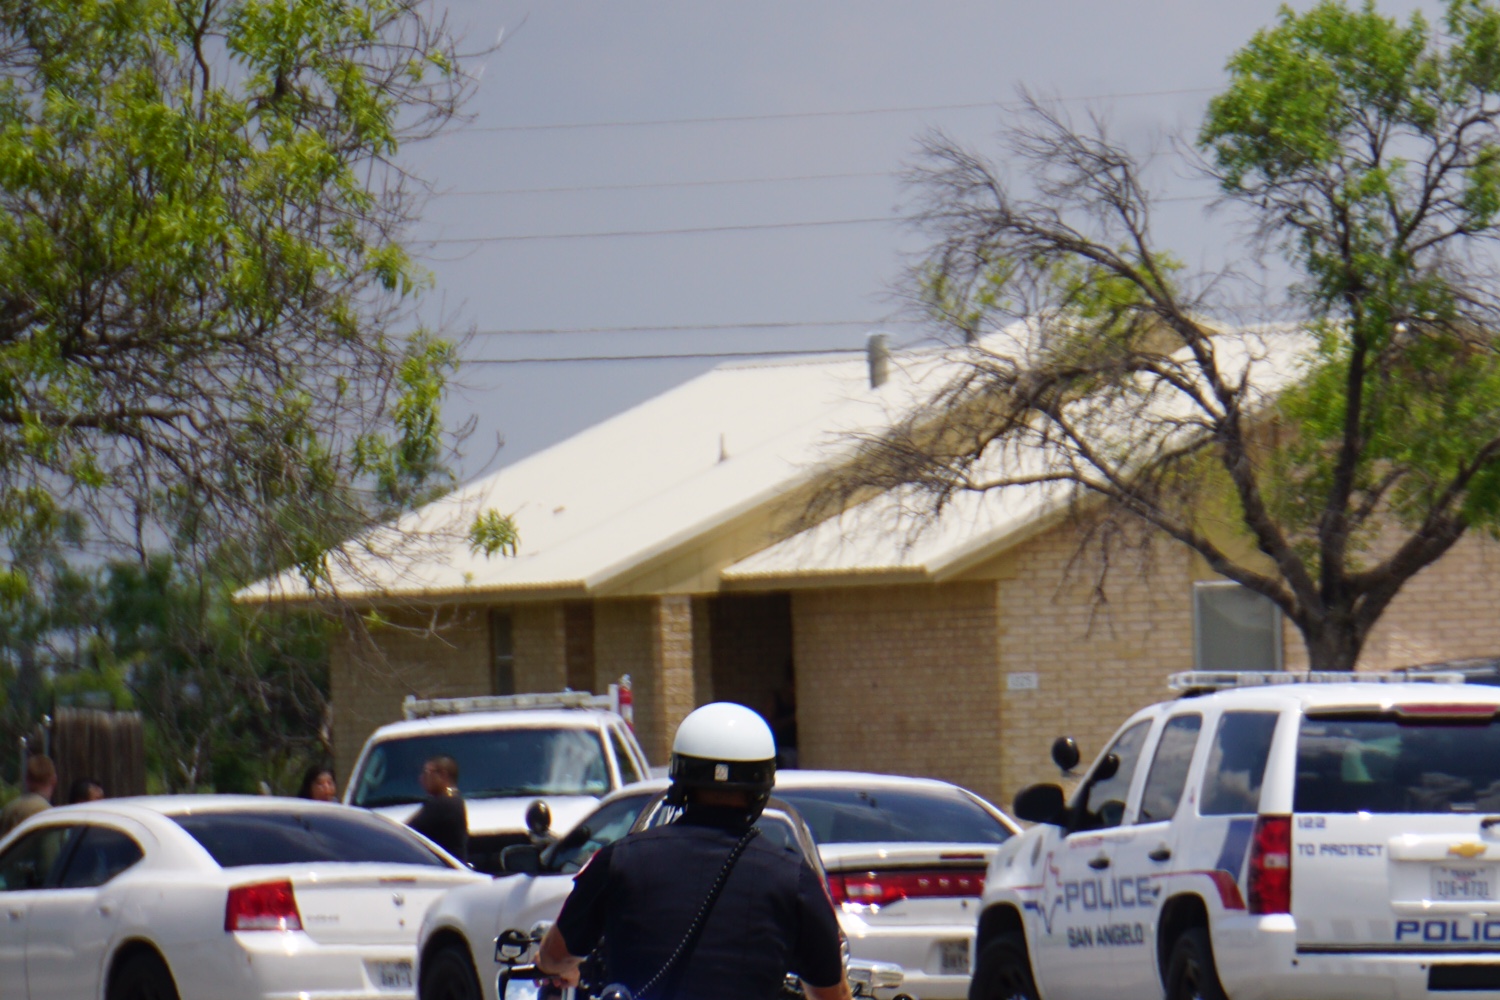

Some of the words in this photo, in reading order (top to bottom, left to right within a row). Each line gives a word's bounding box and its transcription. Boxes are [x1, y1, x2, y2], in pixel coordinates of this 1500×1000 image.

[1298, 843, 1315, 856] TO
[1319, 844, 1383, 857] PROTECT
[1064, 875, 1152, 911] POLICE
[1067, 926, 1092, 948] SAN
[1096, 922, 1144, 945] ANGELO
